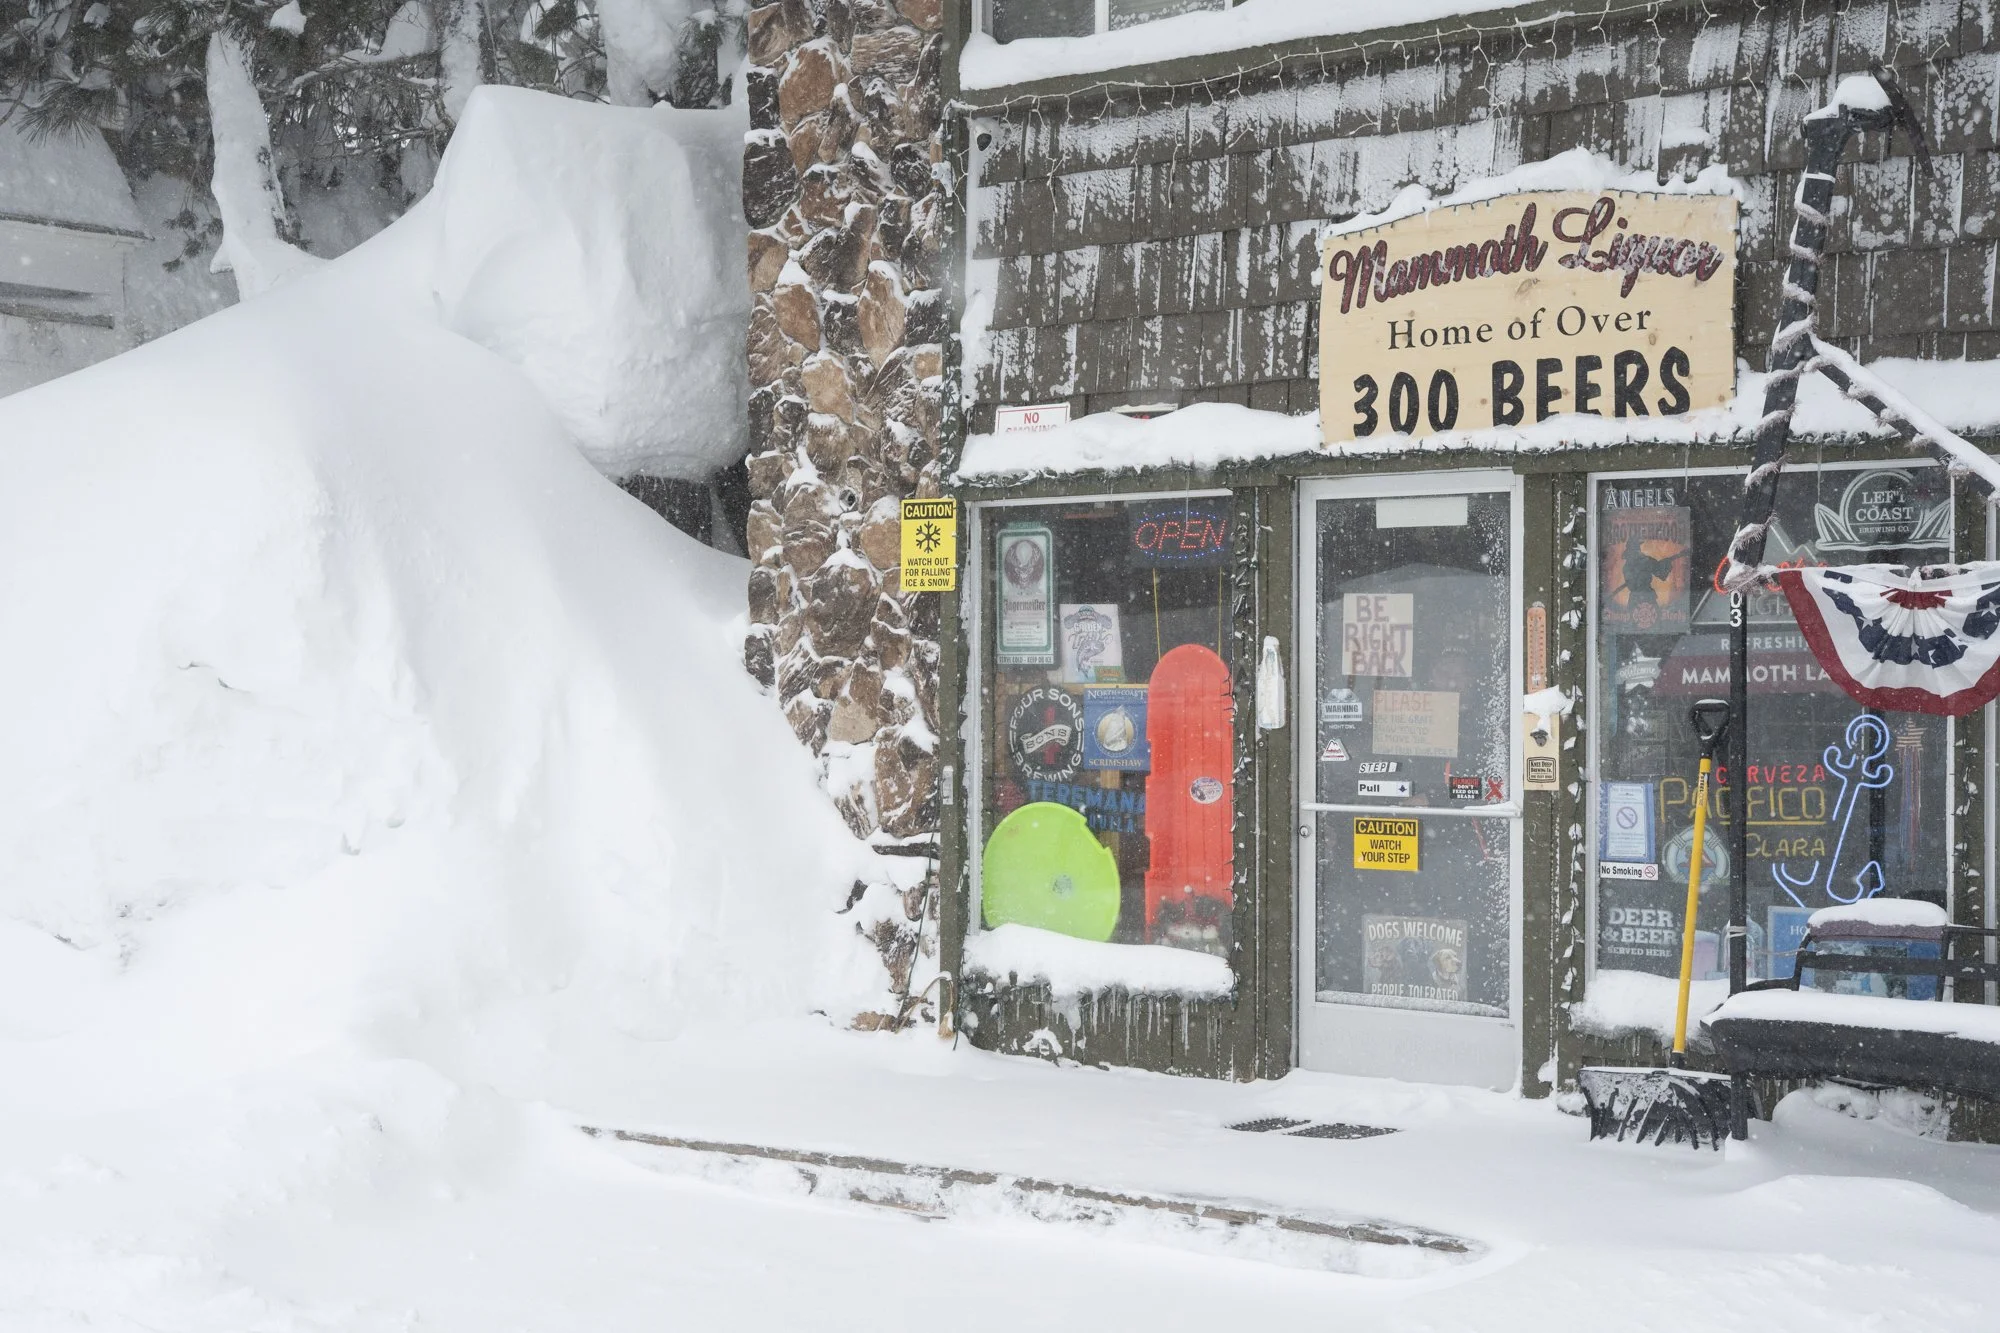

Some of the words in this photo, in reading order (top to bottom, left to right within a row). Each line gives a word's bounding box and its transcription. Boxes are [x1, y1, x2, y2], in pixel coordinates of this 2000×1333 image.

[1330, 202, 1548, 314] Mammoth
[1552, 197, 1724, 298] Liquor
[1387, 318, 1493, 350] Home
[1507, 307, 1546, 340] of
[1557, 304, 1652, 338] Over
[1353, 369, 1459, 437] 300
[1492, 346, 1690, 427] BEERS
[1023, 412, 1040, 424] NO
[1606, 487, 1675, 509] ANGELS
[1862, 490, 1905, 504] LEFT
[905, 504, 952, 517] CAUTION
[1855, 507, 1914, 521] COAST
[1136, 520, 1227, 551] OPEN
[1859, 526, 1896, 534] BREWING
[907, 558, 932, 566] WATCH
[934, 557, 949, 566] OUT
[905, 568, 919, 577] FOR
[921, 568, 950, 577] FALLING
[905, 579, 917, 587] ICE
[919, 579, 925, 587] &
[927, 578, 950, 587] SNOW
[1356, 596, 1390, 622] BE
[1344, 623, 1413, 656] RIGHT
[1352, 651, 1407, 675] BACK
[1681, 664, 1797, 684] MAMOTH
[1087, 689, 1117, 699] NORTH
[1121, 689, 1145, 699] COAST
[1375, 692, 1433, 712] PLEASE
[1010, 689, 1044, 730] FOUR
[1048, 688, 1085, 732] SONS
[1325, 704, 1359, 713] WARNING
[1026, 728, 1067, 749] SONS
[1014, 752, 1082, 782] BREWING
[1088, 758, 1142, 767] SCRIMSHAW
[1360, 763, 1387, 772] STEP
[1715, 764, 1825, 784] CRVEZA
[1359, 784, 1380, 792] Pull
[1660, 777, 1825, 824] PACFICO
[1358, 821, 1414, 835] CAUTION
[1370, 839, 1401, 851] WATCH
[1746, 832, 1826, 857] CLARA
[1361, 851, 1385, 862] YOUR
[1387, 852, 1410, 863] STEP
[1601, 866, 1611, 874] No
[1612, 866, 1642, 878] Smoking
[1609, 907, 1673, 927] DEER
[1368, 921, 1400, 941] DOGS
[1403, 921, 1463, 947] WELCOME
[1601, 926, 1620, 942] &
[1621, 927, 1678, 945] BEER
[1608, 945, 1644, 956] SERVED
[1646, 948, 1673, 958] HERE
[1371, 983, 1404, 997] PEOPLE
[1408, 984, 1458, 1001] TOLERATED
